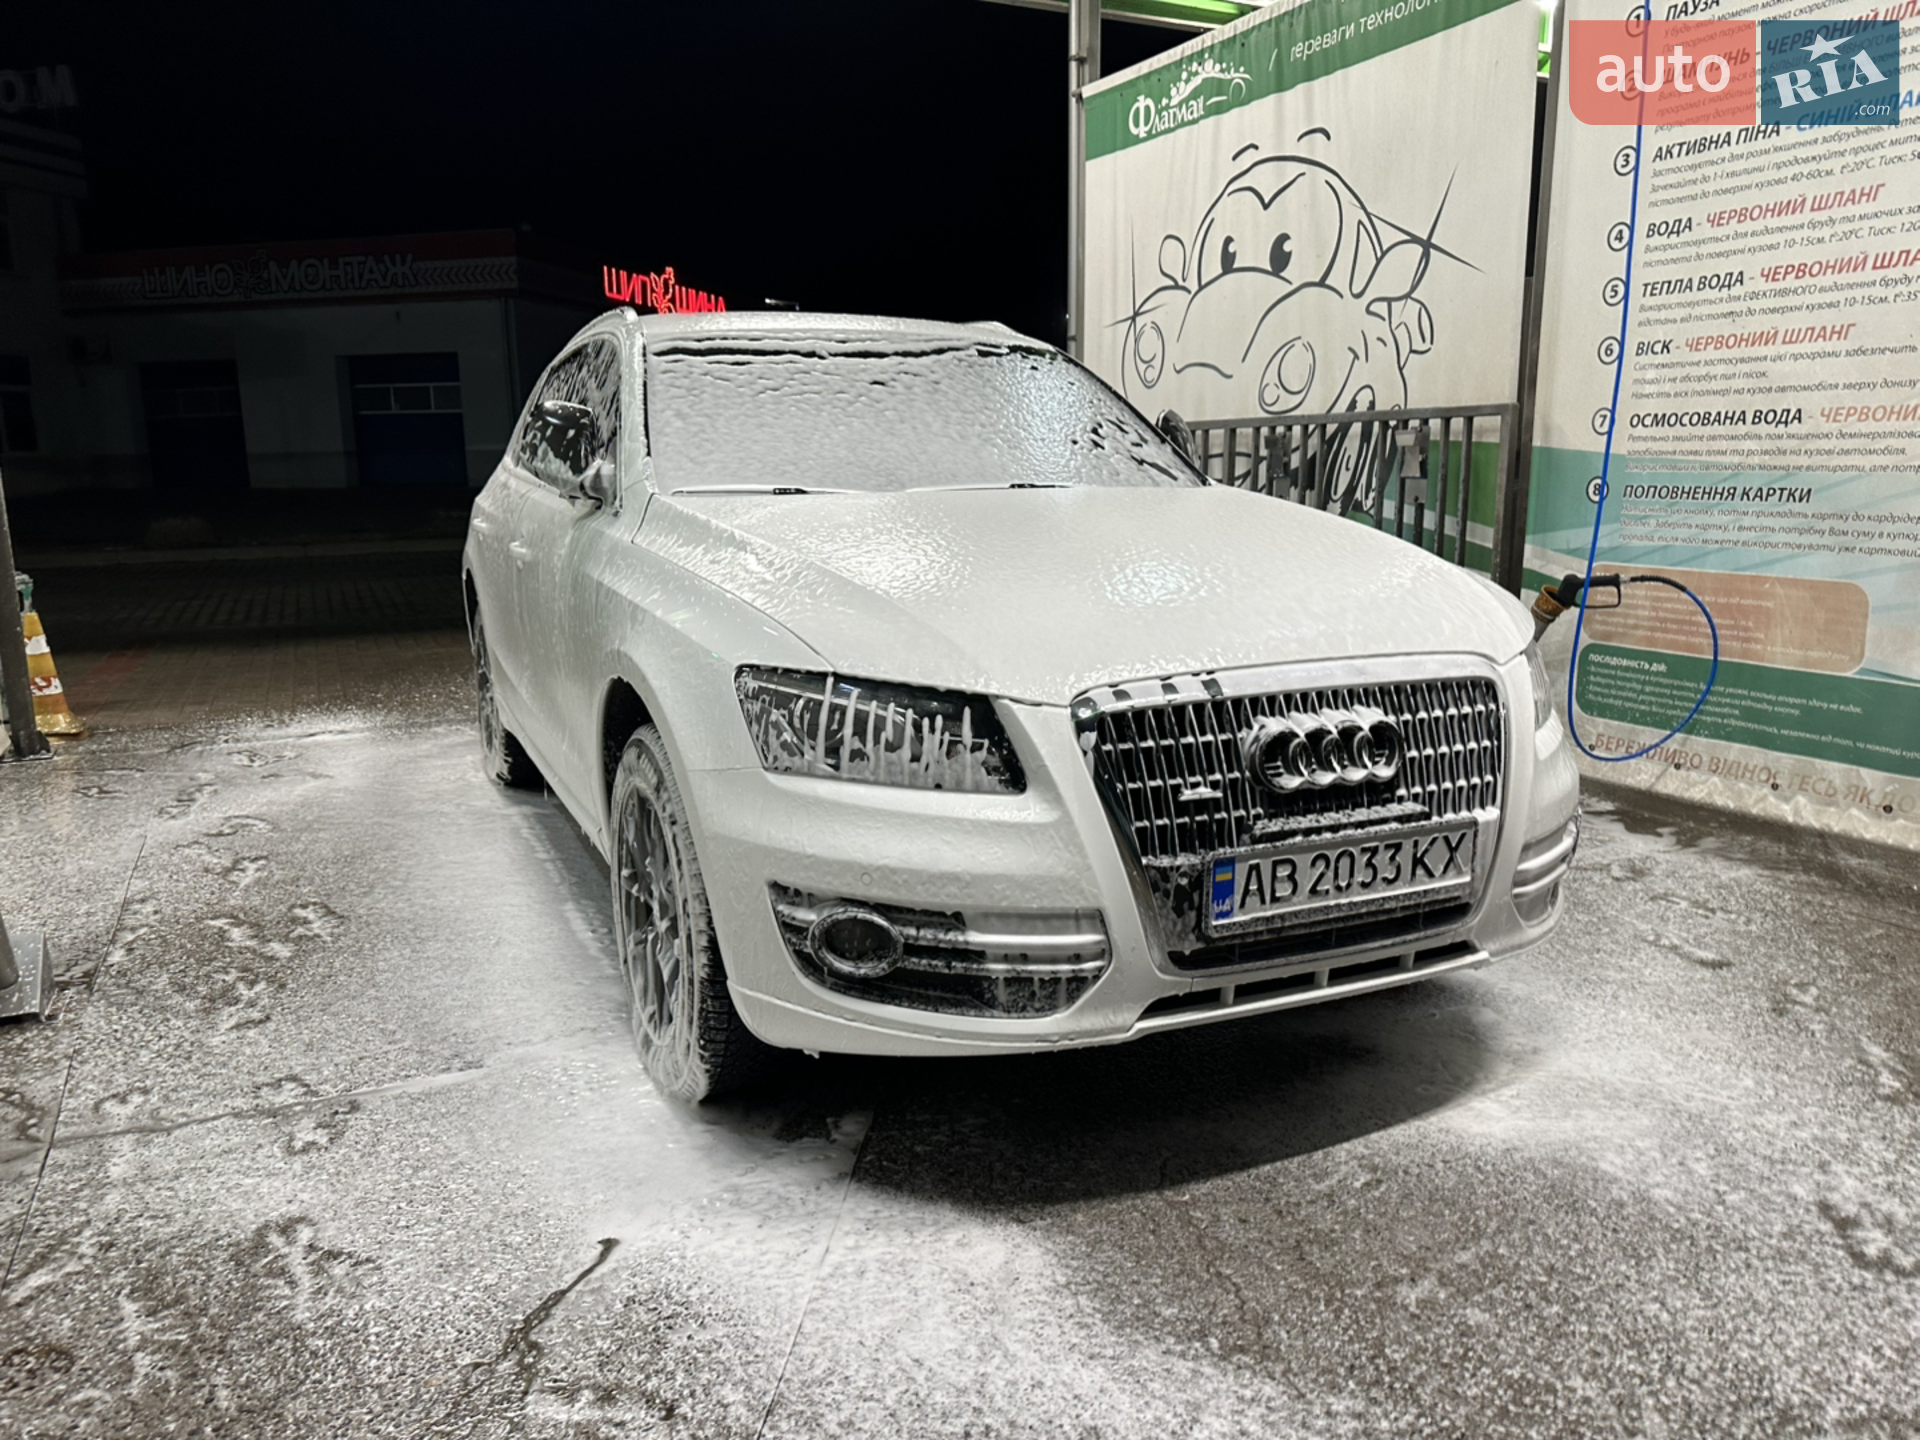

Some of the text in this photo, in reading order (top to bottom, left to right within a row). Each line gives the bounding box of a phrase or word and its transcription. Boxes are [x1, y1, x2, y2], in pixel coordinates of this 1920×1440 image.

[1882, 0, 1920, 26] ШЛ
[1621, 153, 1630, 168] 3
[1652, 131, 1732, 163] АКТИВНА
[1736, 121, 1780, 146] ПІНА
[1614, 183, 1886, 244] 4 ВОДА ЧЕРВОНИЙ ШЛАНГ
[142, 252, 418, 299] ШИНО МОНТАЖ
[603, 265, 652, 307] ШИП
[1609, 284, 1619, 299] 5
[1642, 278, 1693, 298] ТЕПЛА
[1697, 270, 1744, 293] ВОДА
[1760, 251, 1868, 283] ЧЕРВОНИЙ
[1605, 322, 1856, 357] 6 ВІСК ЧЕРВОНИЙ ШЛАНГ
[1599, 403, 1920, 428] 7 ОСМОСОВАНА ВОДА ЧЕРВОНИ
[1622, 484, 1737, 501] ПОПОВНЕННЯ
[1740, 486, 1812, 503] КАРТКИ
[1308, 842, 1403, 896] 2033
